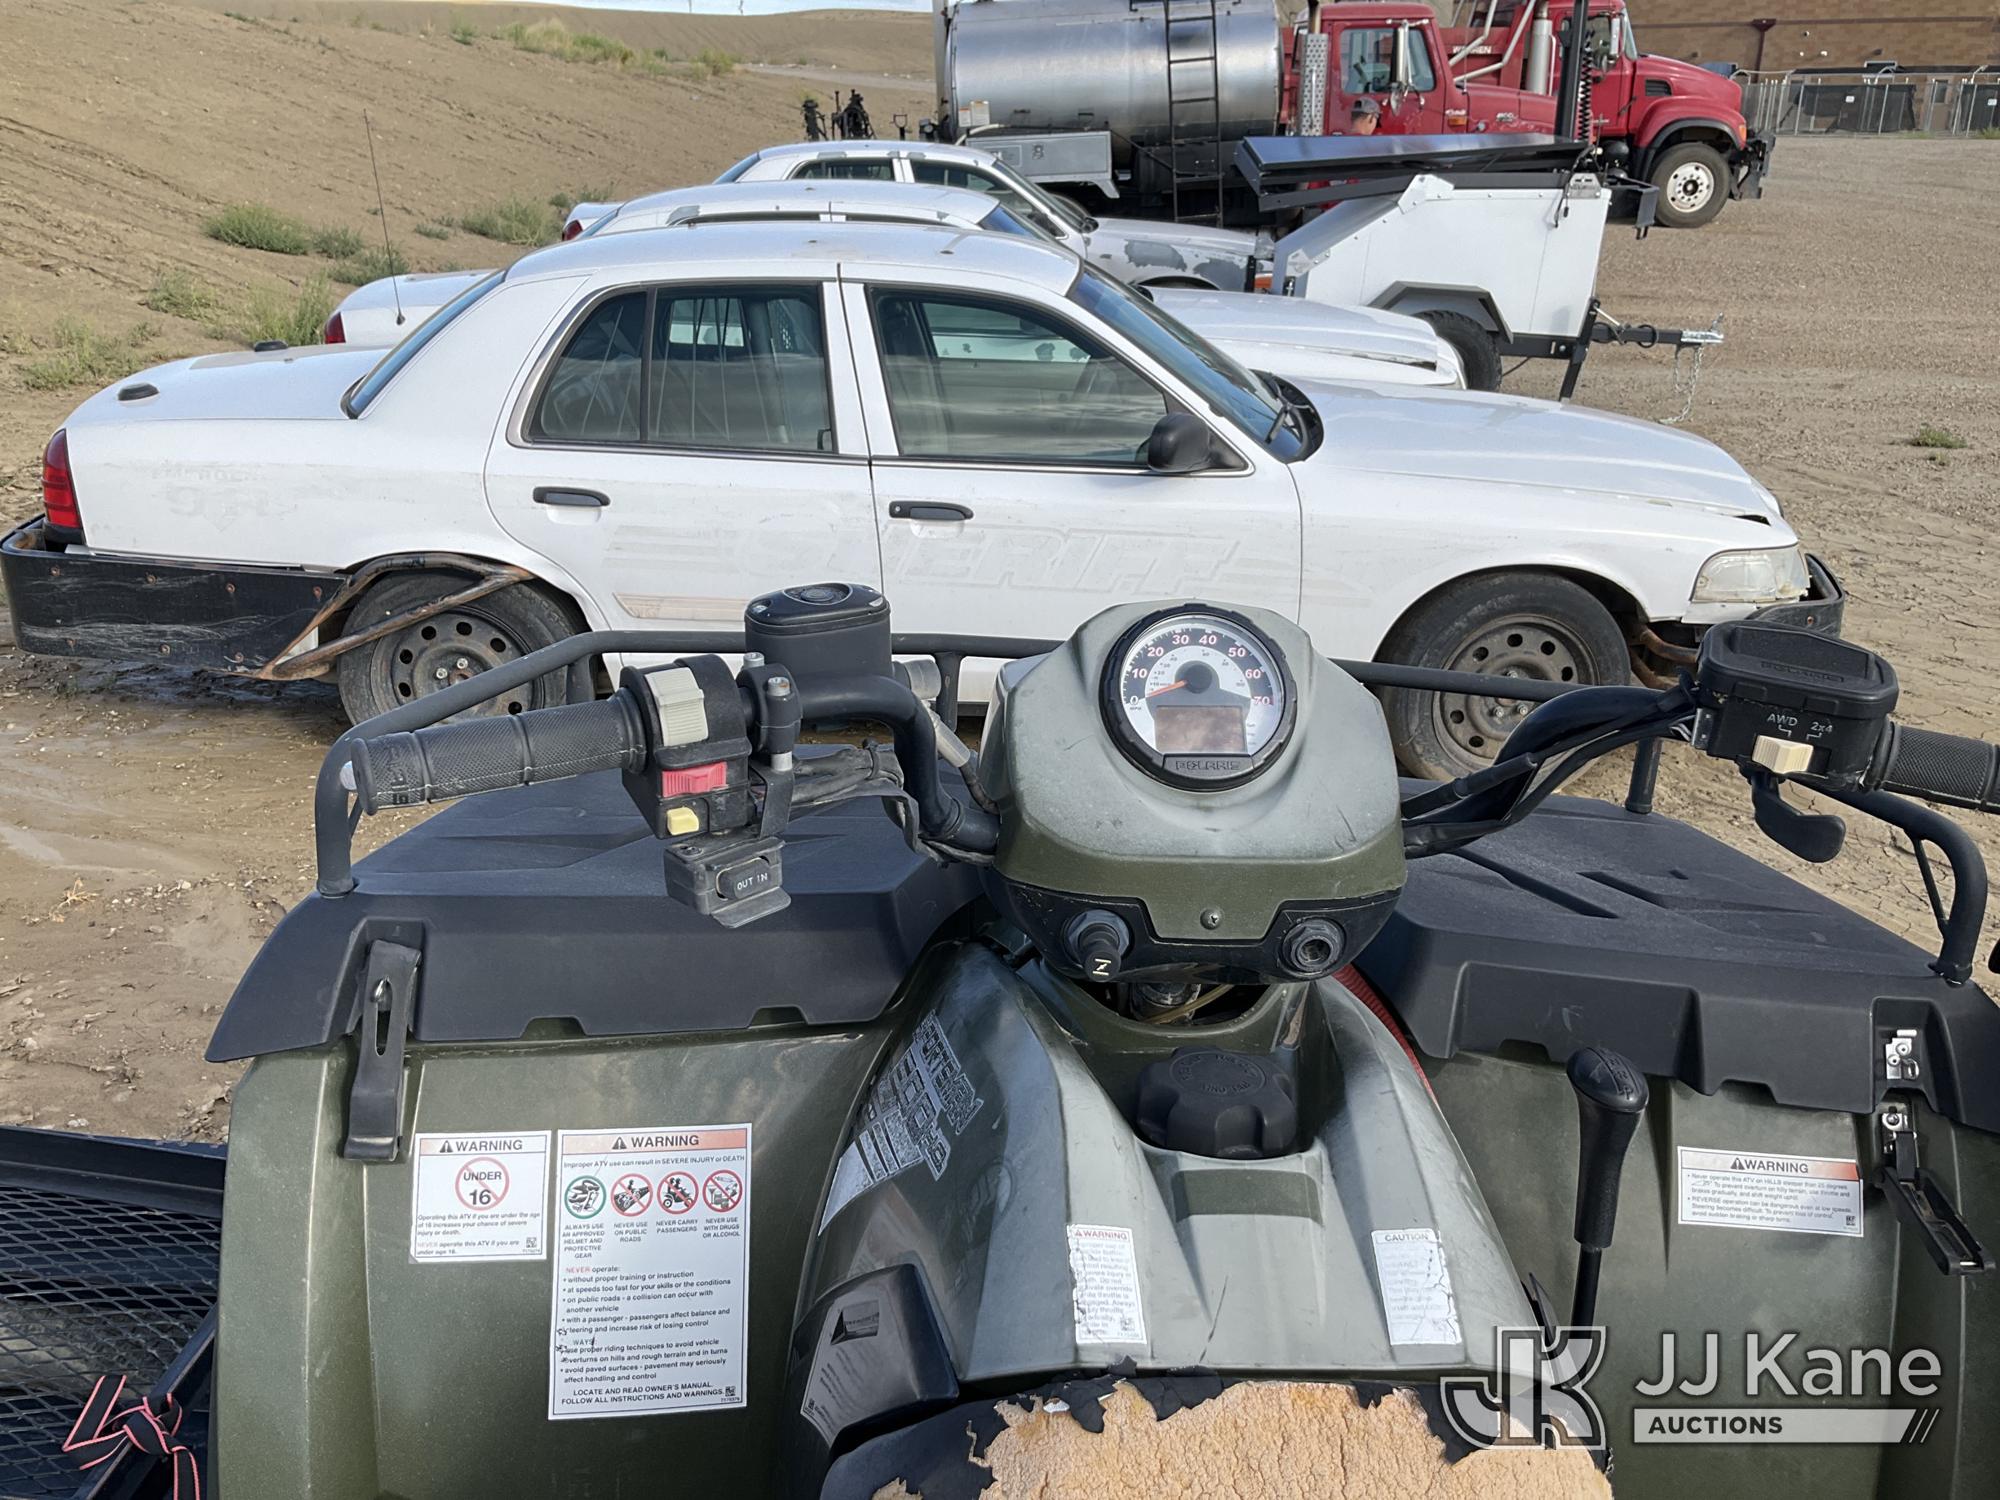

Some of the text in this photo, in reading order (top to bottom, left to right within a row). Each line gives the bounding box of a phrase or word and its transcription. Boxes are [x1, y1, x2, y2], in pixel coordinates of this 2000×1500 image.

[1172, 635, 1189, 645] 30
[1199, 635, 1217, 645] 40
[1148, 647, 1164, 657] 20
[1228, 647, 1246, 658] 50
[1131, 668, 1148, 679] 10
[1245, 669, 1262, 679] 60
[1130, 695, 1139, 706] 0
[1254, 696, 1271, 705] 70
[1767, 713, 1798, 726] AWD
[737, 872, 768, 890] OUT IN
[456, 1140, 523, 1152] WARNING
[632, 1135, 700, 1148] WARNING
[1745, 1160, 1809, 1174] WARNING
[464, 1171, 502, 1181] UNDER
[469, 1189, 492, 1206] 16
[1082, 1230, 1128, 1240] WARNING
[595, 1275, 618, 1283] proper
[620, 1274, 646, 1282] training
[657, 1271, 694, 1279] instruction
[576, 1286, 600, 1294] speeds
[588, 1316, 624, 1324] passenger
[630, 1313, 669, 1322] passengers
[691, 1309, 716, 1317] balance
[567, 1326, 593, 1334] teering
[685, 1320, 709, 1328] control
[626, 1343, 664, 1351] techniques
[695, 1338, 719, 1346] vehicle
[644, 1362, 678, 1370] pavement
[696, 1358, 726, 1366] seriously
[645, 1384, 679, 1392] OWNER'S
[681, 1381, 713, 1390] MANUAL.
[562, 1397, 593, 1405] FOLLOW
[610, 1393, 664, 1402] INSTRUCTIONS
[684, 1388, 724, 1397] WARNINGS.
